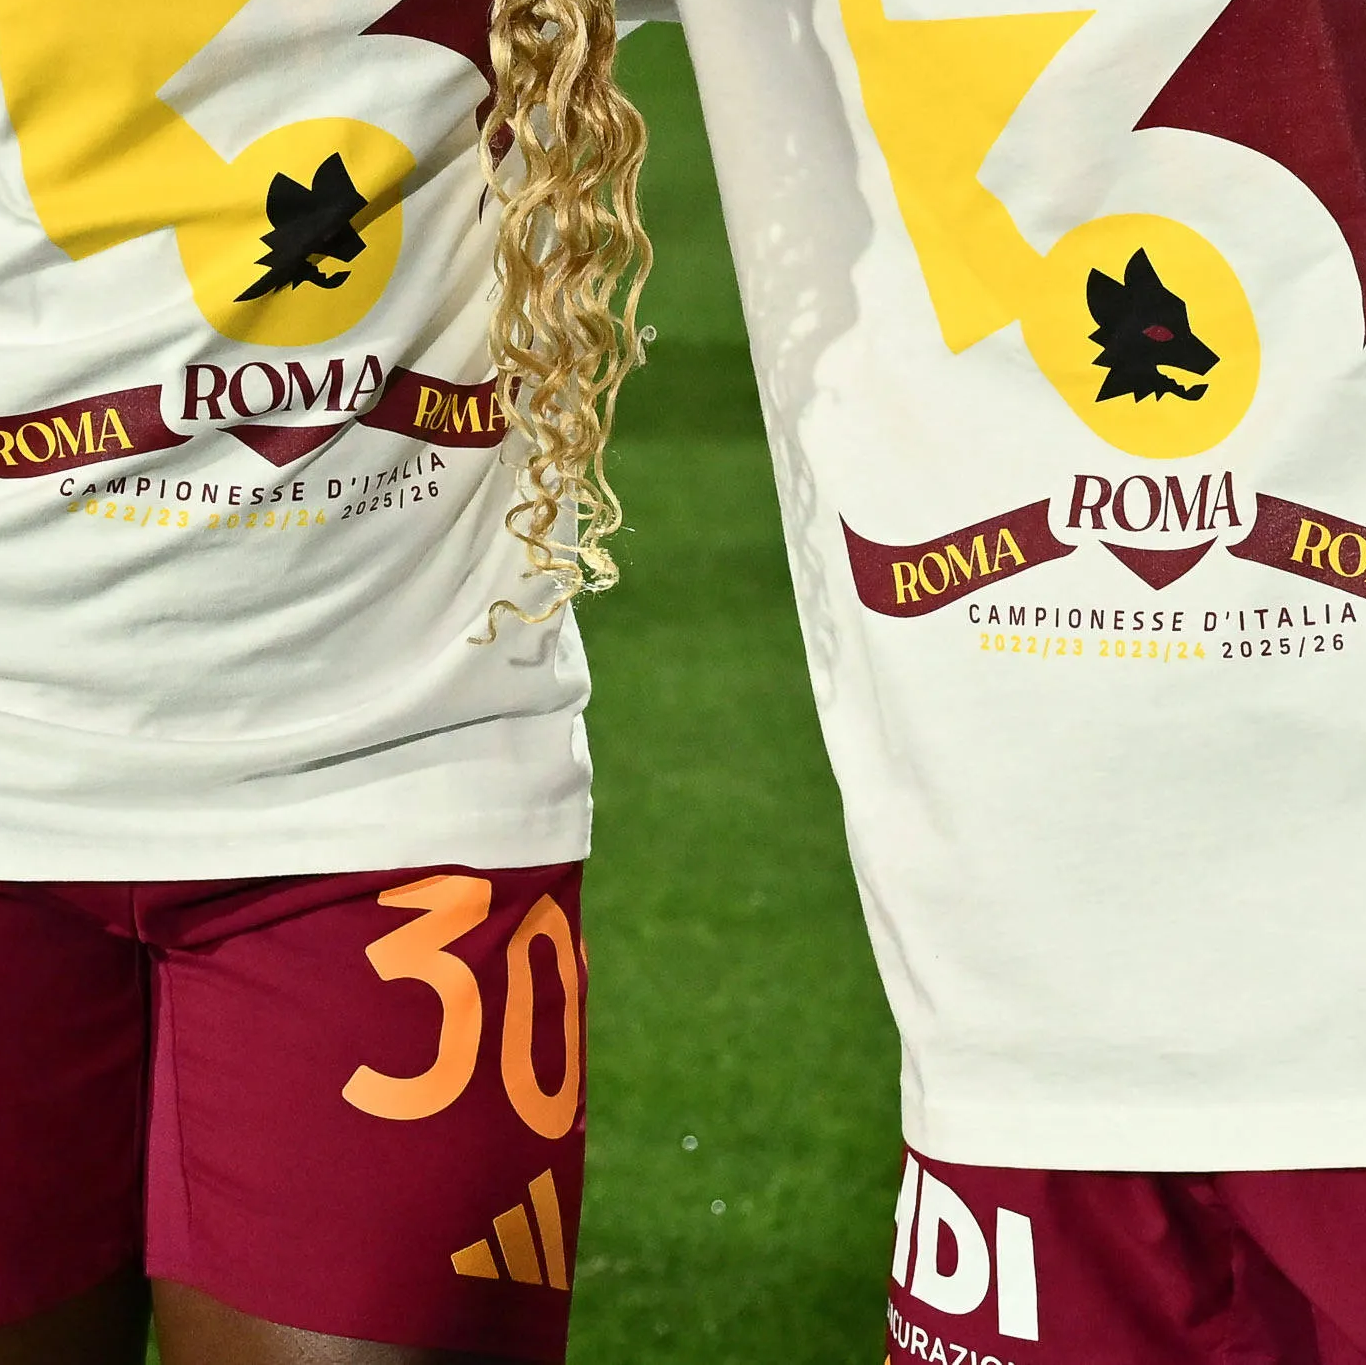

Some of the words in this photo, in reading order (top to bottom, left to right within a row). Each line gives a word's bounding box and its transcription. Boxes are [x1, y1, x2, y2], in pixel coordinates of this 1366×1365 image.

[181, 354, 384, 421] ROMA
[59, 476, 305, 507] CAMPIONESSE
[327, 451, 446, 500] D'ITALIA
[66, 498, 190, 528] 2022/23
[208, 508, 326, 531] 2023/24
[341, 480, 440, 520] 2025/26
[1065, 470, 1243, 533] ROMA
[891, 527, 1027, 605] ROMA
[968, 603, 1184, 632] CAMPIONESSE
[1203, 601, 1357, 632] D'ITALIA
[979, 632, 1084, 660] 2022/23
[1098, 638, 1207, 663] 2023/24
[1221, 633, 1344, 659] 2025/26
[341, 874, 580, 1140] 30
